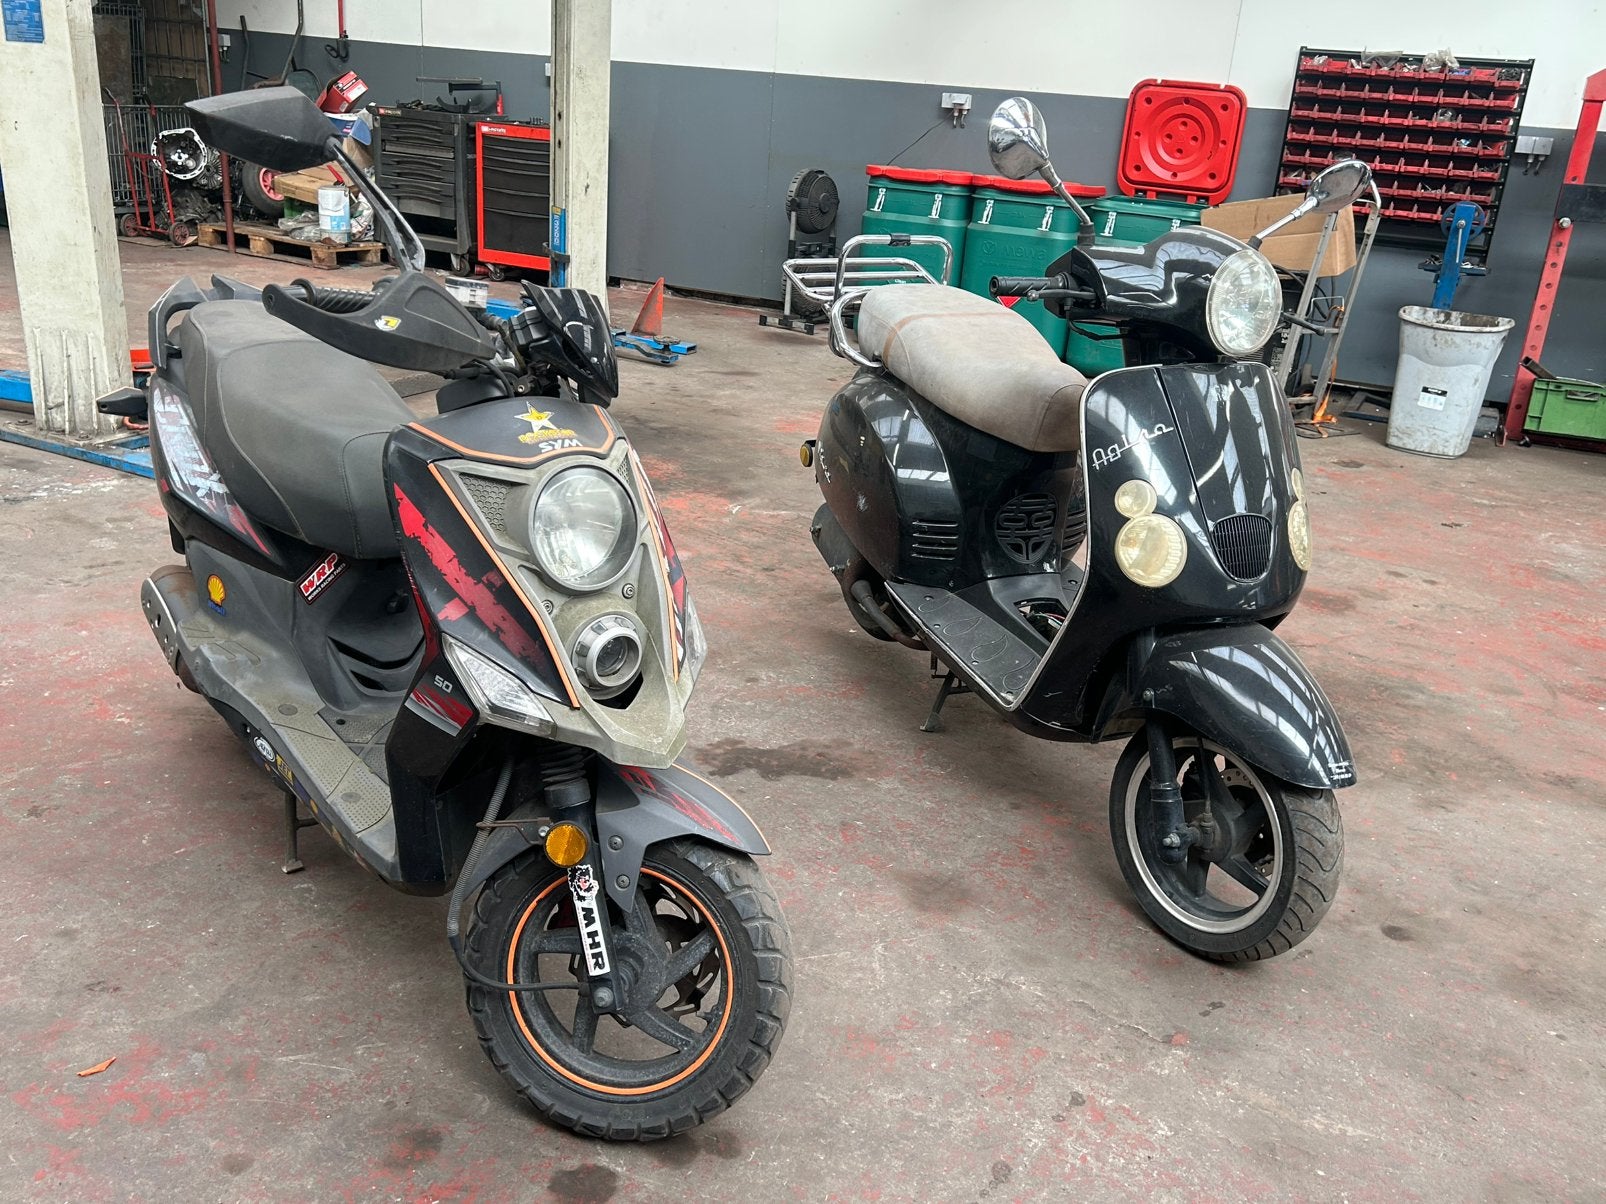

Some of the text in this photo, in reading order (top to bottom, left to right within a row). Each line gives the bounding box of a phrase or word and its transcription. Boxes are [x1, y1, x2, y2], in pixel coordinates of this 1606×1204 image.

[538, 438, 583, 453] SYM
[299, 552, 338, 597] WRP
[321, 574, 335, 588] RACING
[333, 562, 346, 576] PARTS
[433, 674, 453, 694] 50
[581, 906, 606, 972] MHR
